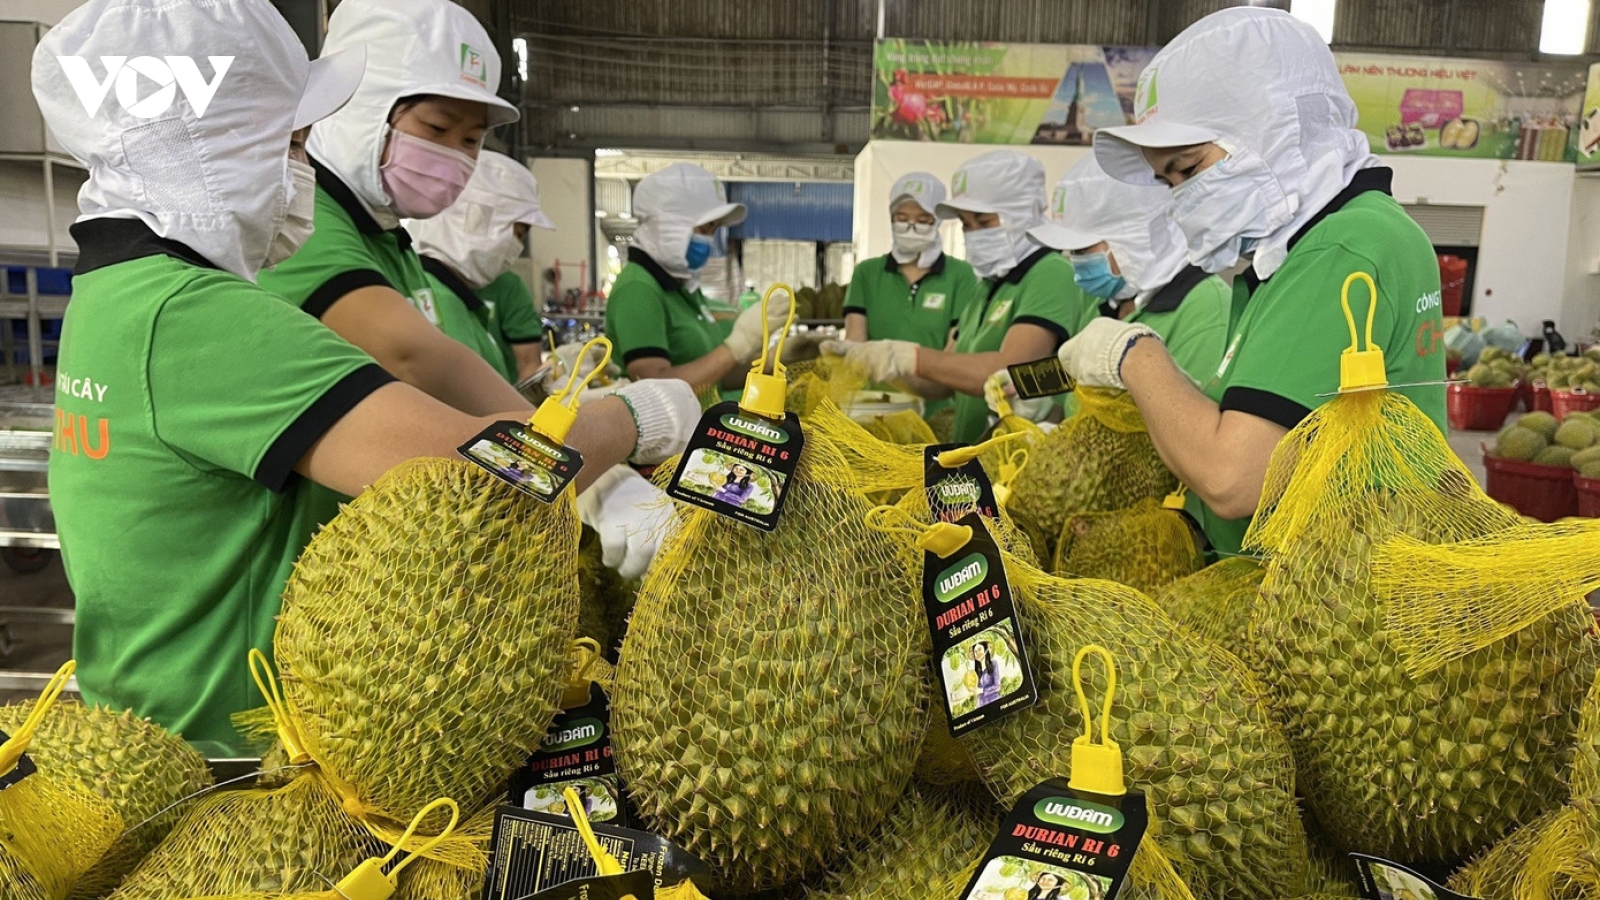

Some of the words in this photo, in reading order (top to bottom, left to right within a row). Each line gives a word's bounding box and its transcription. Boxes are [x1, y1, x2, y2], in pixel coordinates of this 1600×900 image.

[71, 377, 108, 403] CÂY
[496, 432, 541, 458] DURIAN
[543, 456, 558, 467] RI
[706, 427, 758, 450] DURIAN
[761, 445, 778, 457] RI
[780, 450, 790, 460] 6
[715, 441, 732, 453] Sầu
[732, 445, 755, 460] riêng
[755, 453, 767, 462] Ri
[985, 506, 993, 517] 6
[936, 597, 976, 631] DURIAN
[976, 589, 991, 609] RI
[991, 584, 1000, 600] 6
[948, 624, 962, 639] Sầu
[961, 616, 980, 632] riêng
[979, 612, 988, 623] Ri
[988, 607, 994, 618] 6
[531, 752, 580, 773] DURIAN
[585, 748, 599, 762] RI
[603, 746, 612, 758] 6
[543, 769, 559, 779] Sầu
[560, 766, 582, 777] riêng
[583, 765, 593, 773] Ri
[1011, 823, 1079, 849] DURIAN
[1081, 839, 1105, 854] RI
[1107, 844, 1121, 858] 6
[1021, 841, 1041, 855] Sầu
[1042, 847, 1072, 863] riêng
[1072, 852, 1086, 865] Ri
[1087, 857, 1096, 867] 6
[655, 845, 668, 876] Frozen
